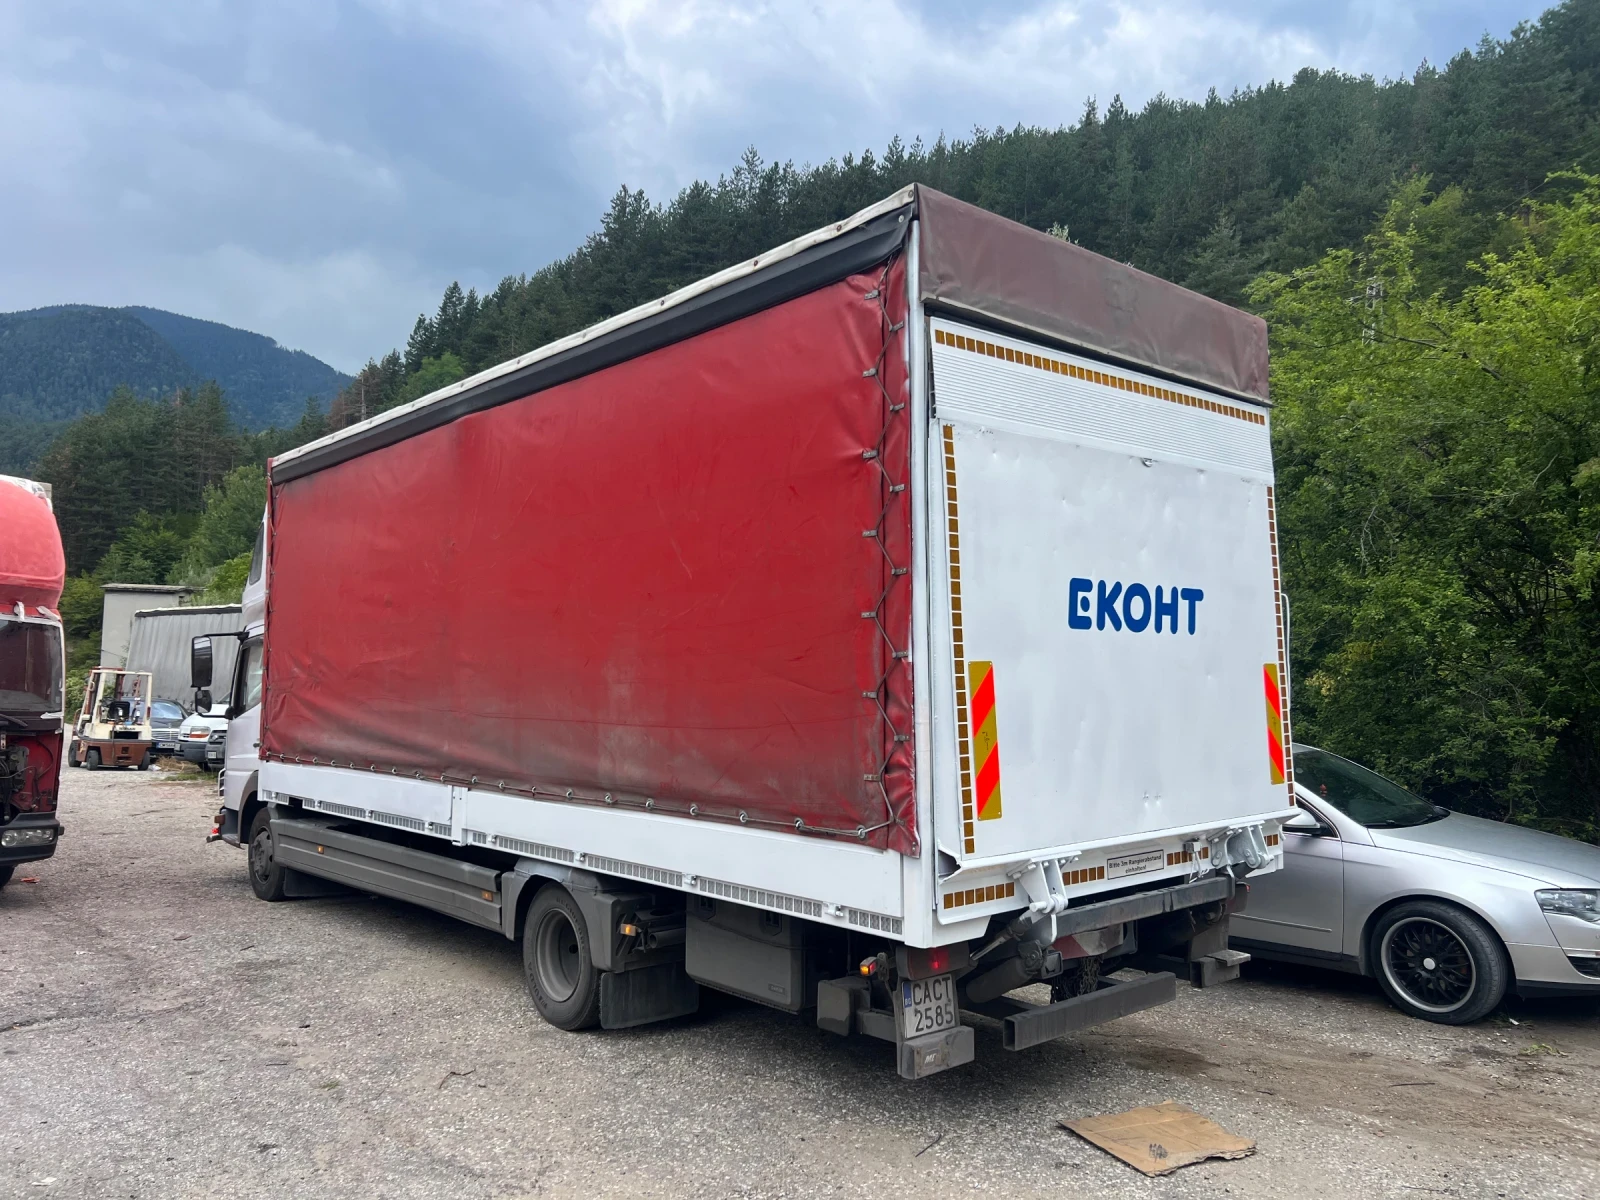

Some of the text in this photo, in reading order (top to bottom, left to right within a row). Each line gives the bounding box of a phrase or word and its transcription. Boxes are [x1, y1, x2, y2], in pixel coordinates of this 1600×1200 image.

[1068, 577, 1205, 636] ЕКОНТ
[912, 976, 951, 1006] CACT
[914, 1003, 954, 1033] 2585
